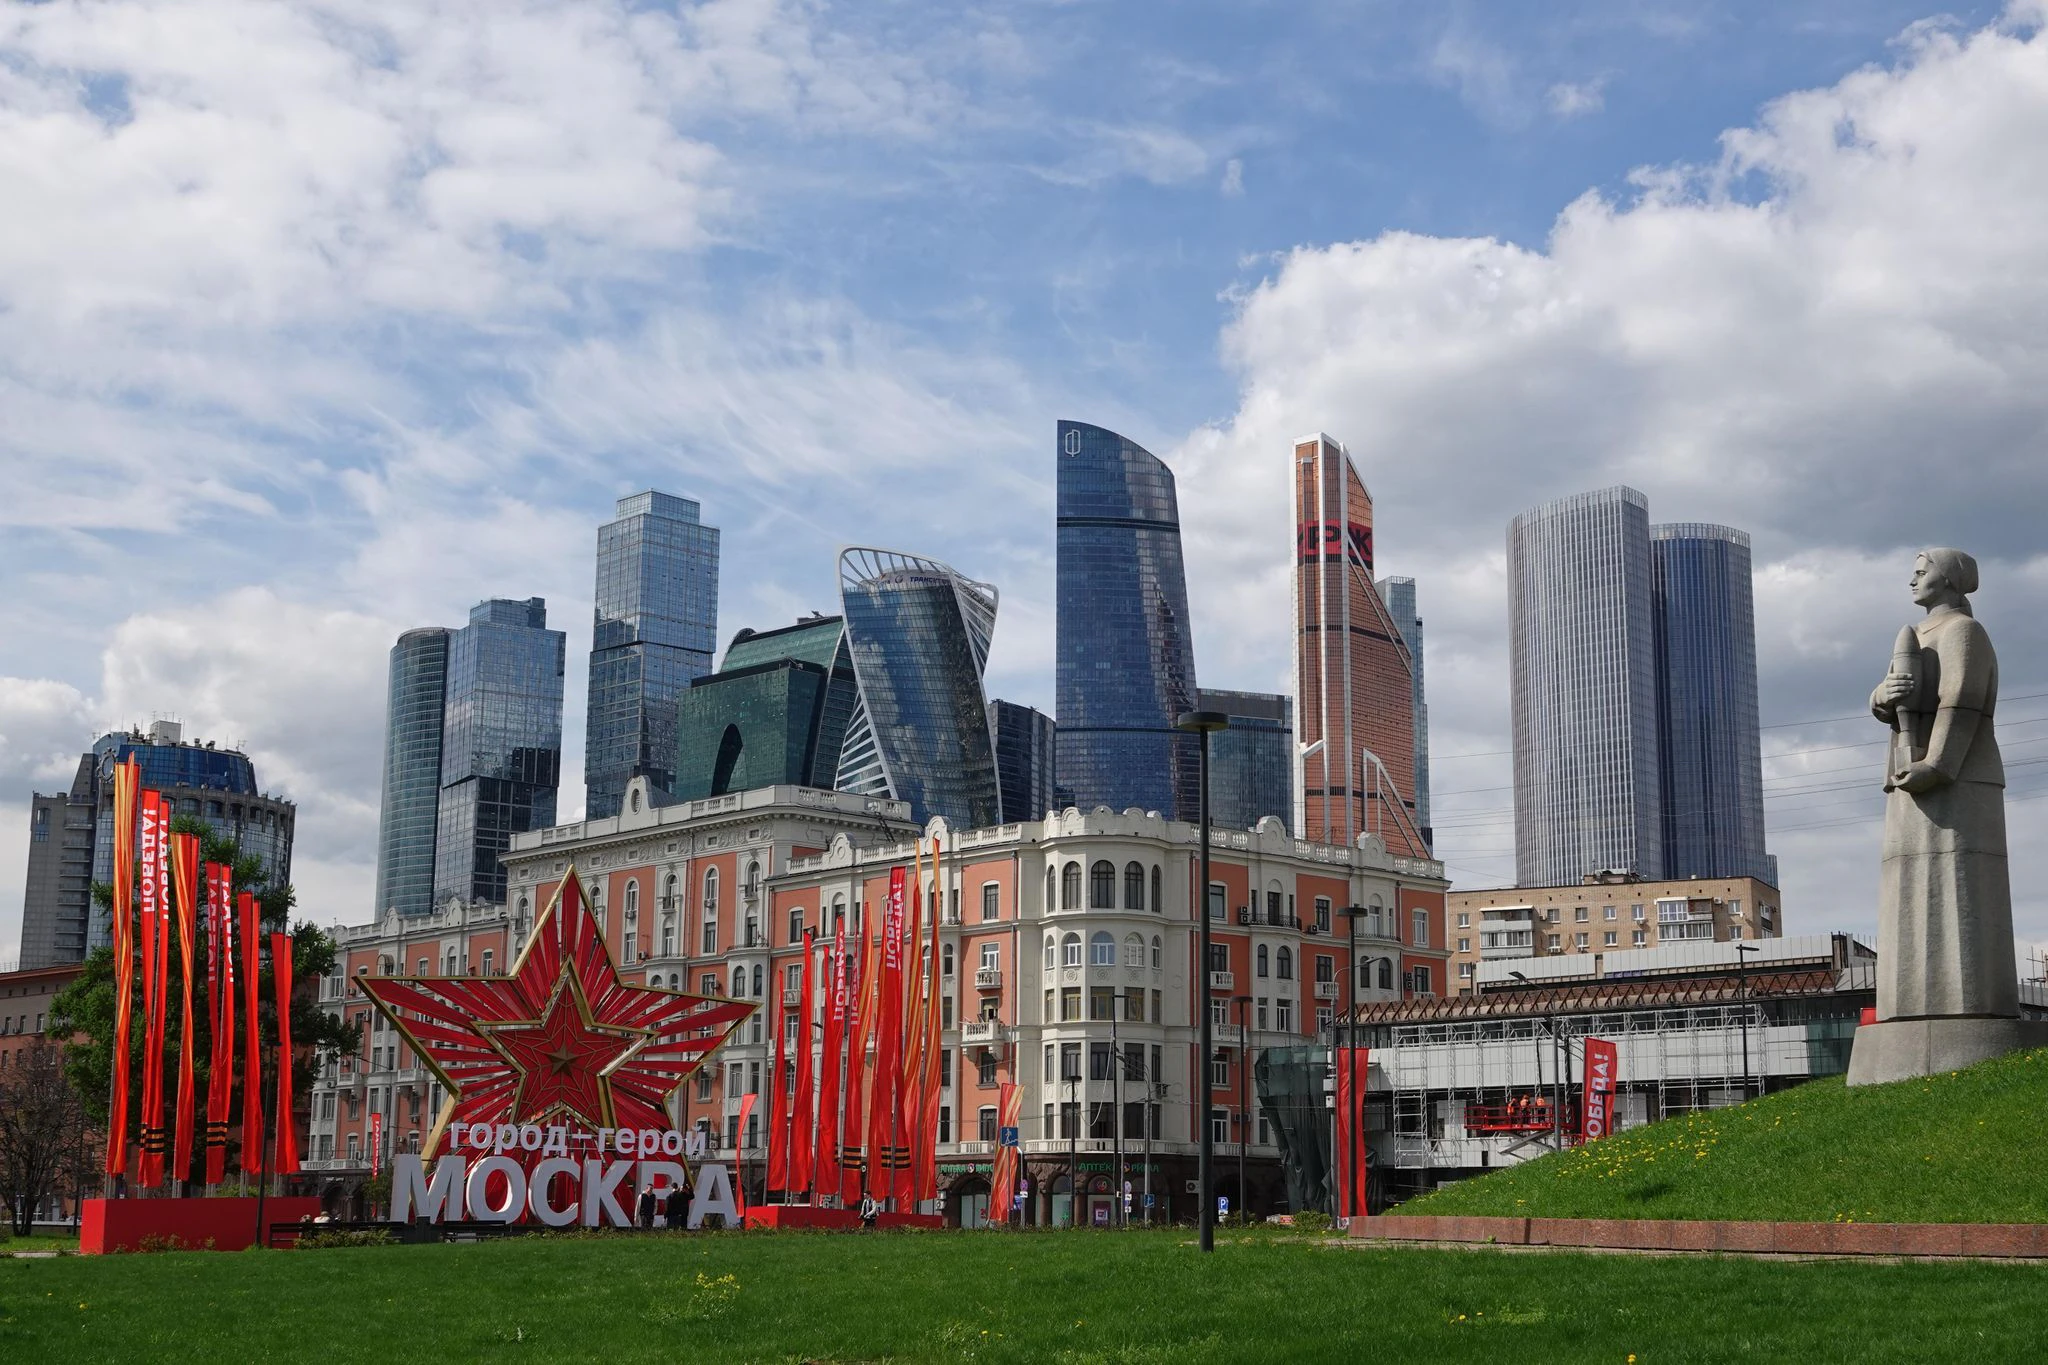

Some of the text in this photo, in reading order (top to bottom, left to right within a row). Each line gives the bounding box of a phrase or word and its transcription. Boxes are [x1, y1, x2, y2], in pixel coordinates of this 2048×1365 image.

[1586, 1053, 1609, 1139] ОБЕДА!
[390, 1154, 743, 1230] МОСКВА
[1079, 1162, 1113, 1173] АПТЕК
